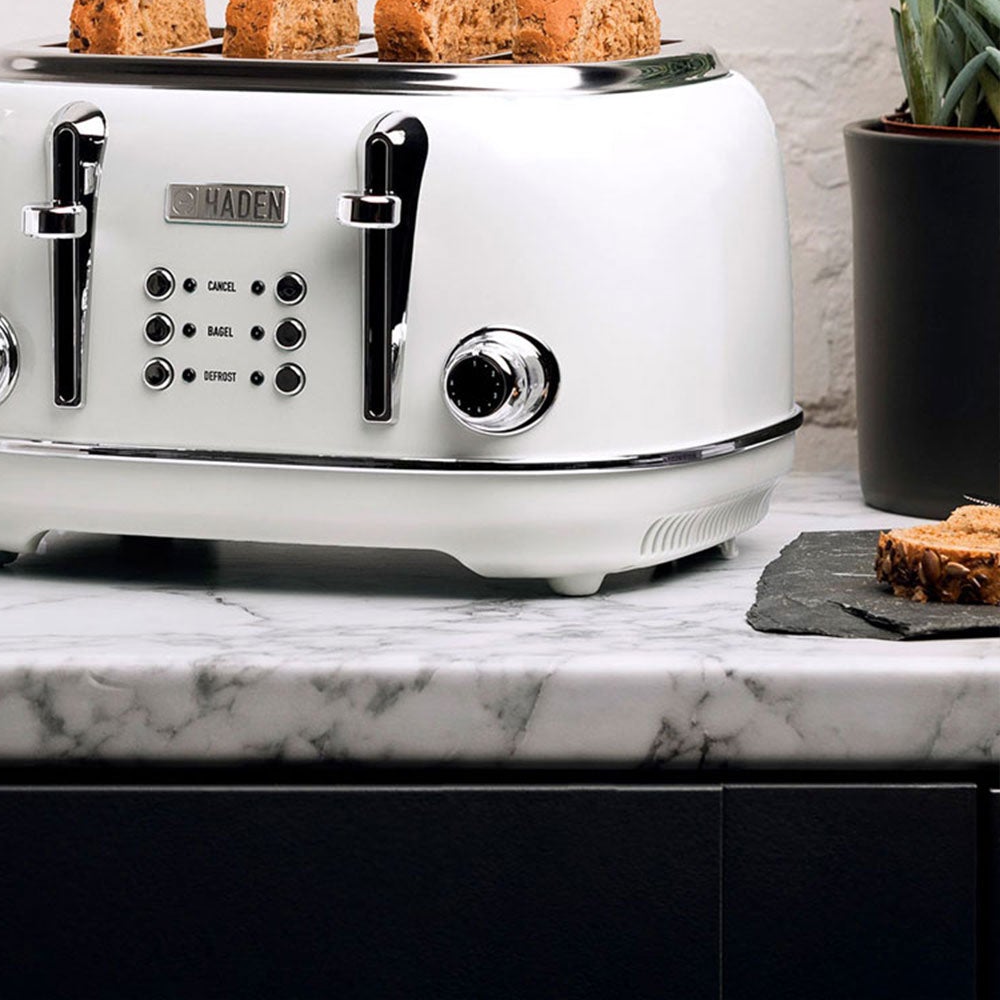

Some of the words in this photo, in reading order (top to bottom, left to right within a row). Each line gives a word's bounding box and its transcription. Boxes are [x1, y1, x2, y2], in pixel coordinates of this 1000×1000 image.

[205, 187, 284, 220] HADEN
[207, 280, 237, 292] CANCEL
[207, 326, 234, 337] BAGEL
[203, 371, 237, 382] DEFROST
